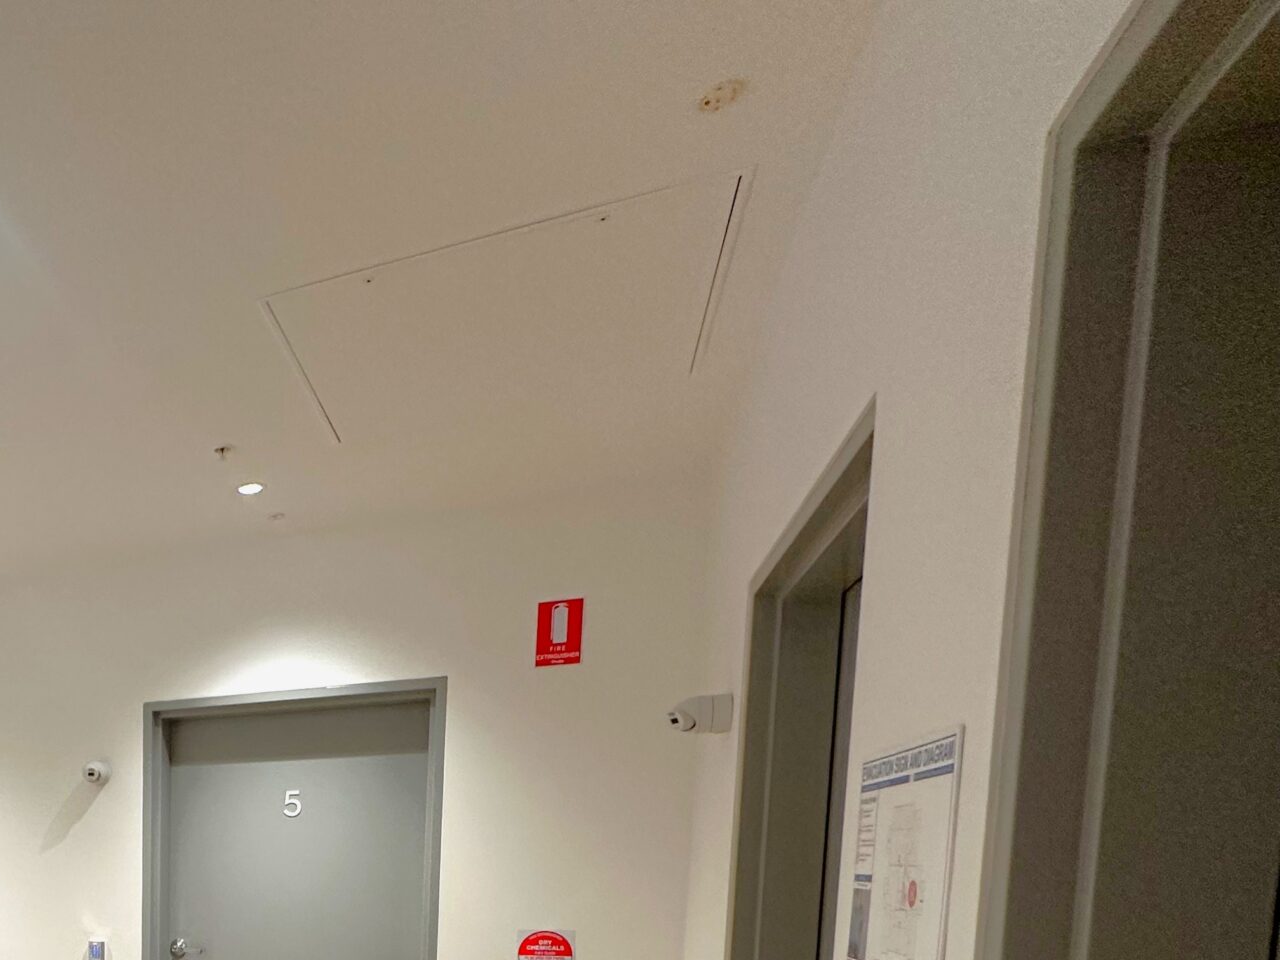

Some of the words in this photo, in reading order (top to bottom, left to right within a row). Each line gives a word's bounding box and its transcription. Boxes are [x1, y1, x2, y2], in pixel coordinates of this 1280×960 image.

[536, 652, 580, 660] EXTINGUISHER
[863, 759, 894, 782] EVACUATION
[283, 790, 302, 817] 5
